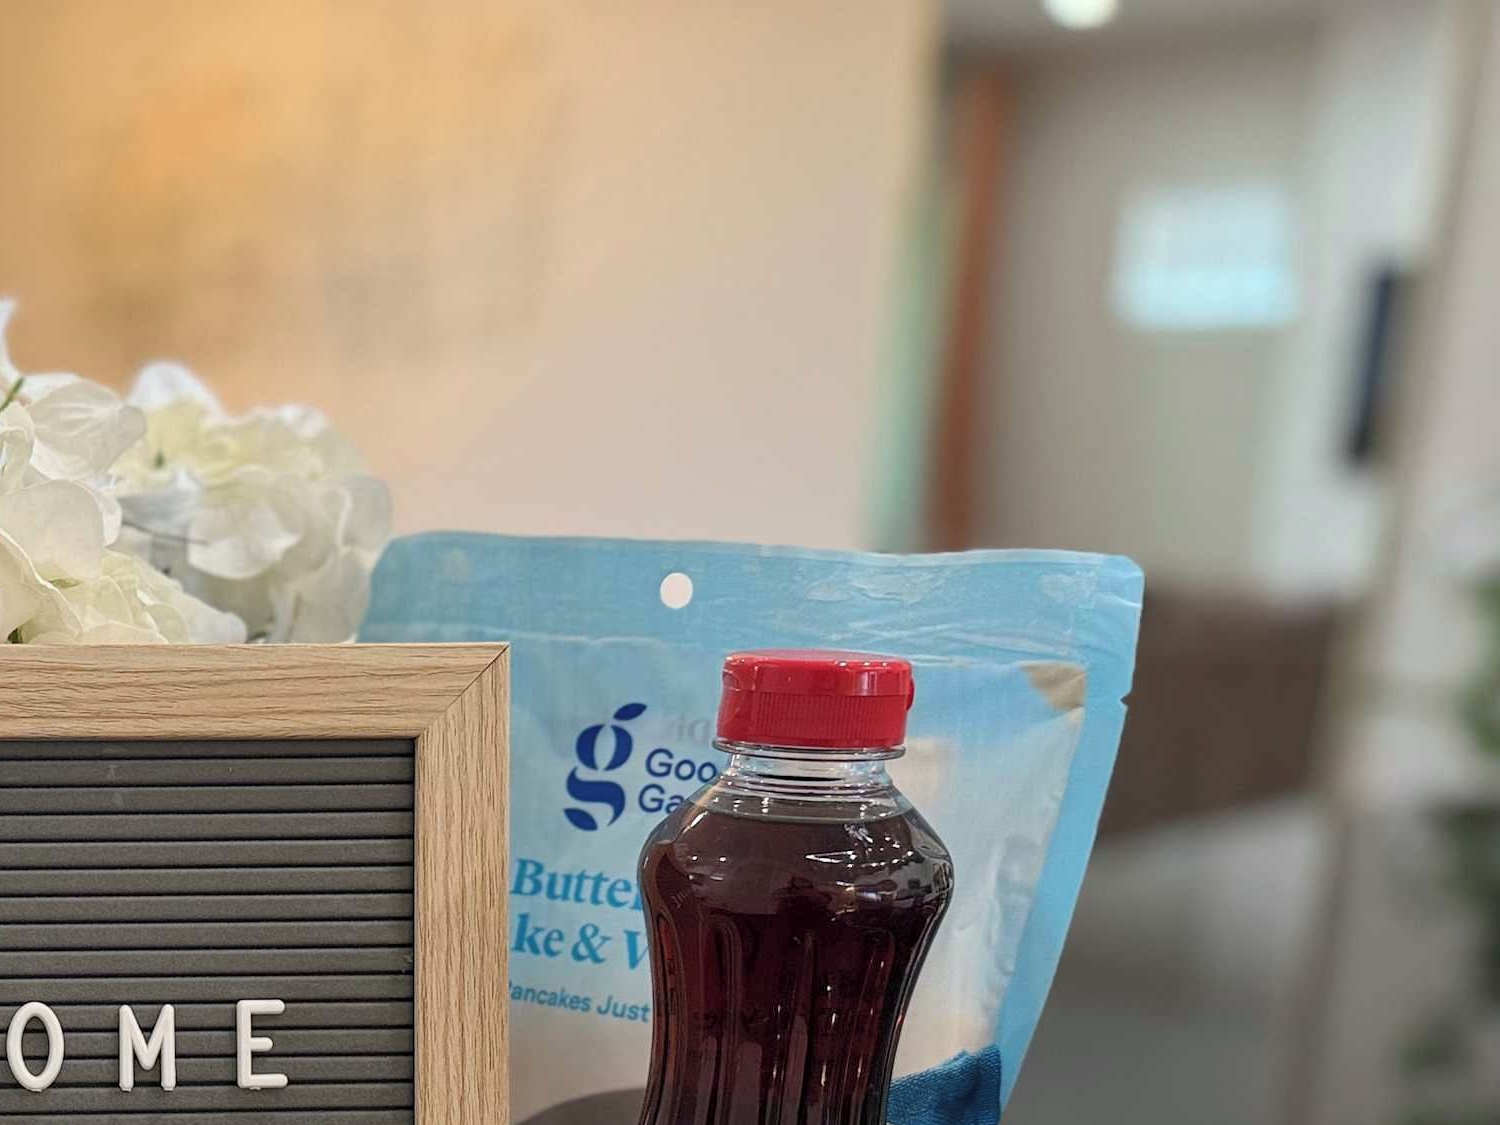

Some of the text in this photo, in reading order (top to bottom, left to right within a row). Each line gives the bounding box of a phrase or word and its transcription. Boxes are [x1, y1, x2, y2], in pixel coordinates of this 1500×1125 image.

[571, 922, 611, 965] &
[508, 979, 651, 1022] ancakes Just
